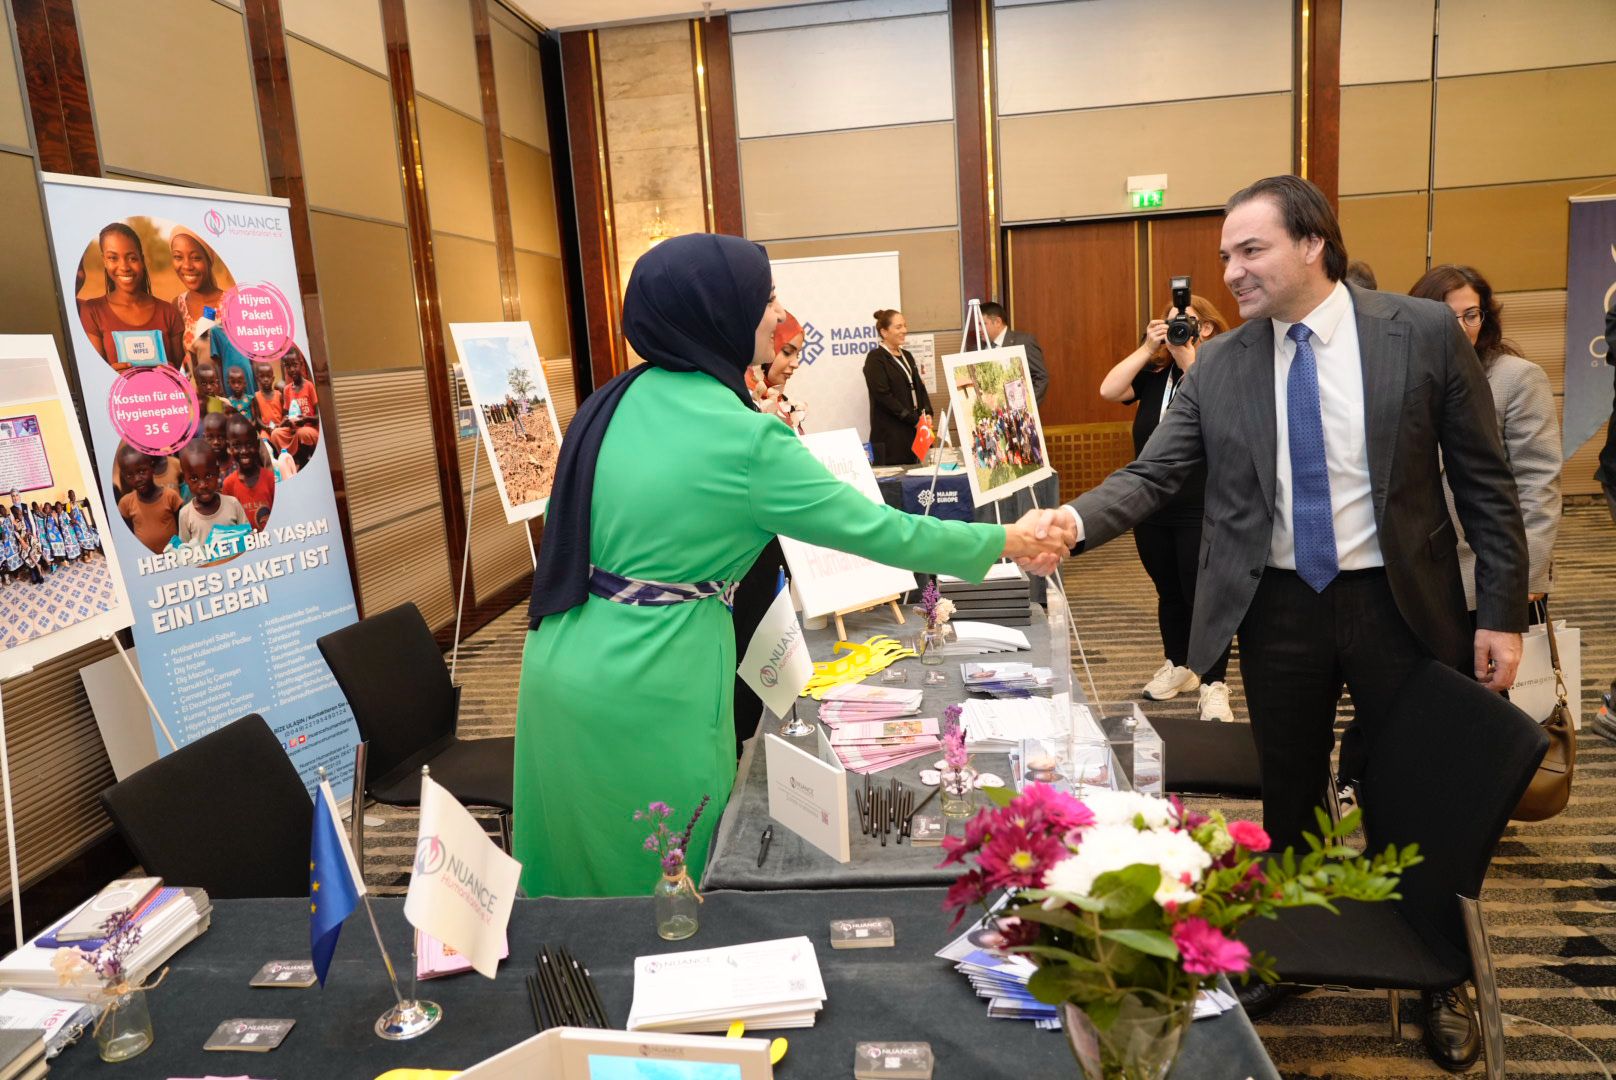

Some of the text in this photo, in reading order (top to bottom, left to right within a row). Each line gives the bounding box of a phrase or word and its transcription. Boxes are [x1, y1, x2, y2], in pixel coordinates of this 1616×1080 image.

[226, 214, 282, 231] NUANCE
[238, 294, 271, 307] Hijyen
[241, 309, 273, 320] Paketi
[236, 325, 283, 338] Maaliyeti
[252, 340, 274, 351] 35 €
[832, 341, 880, 356] EUROP
[113, 390, 186, 405] Kosten für ein
[116, 405, 189, 422] Hygienepaket
[144, 422, 170, 436] 35 €
[138, 518, 329, 576] HER PAKET BİR YAŞAM
[149, 545, 329, 609] JEDES PAKET IST
[151, 584, 269, 634] EIN LEBEN
[446, 855, 497, 914] NUANCE
